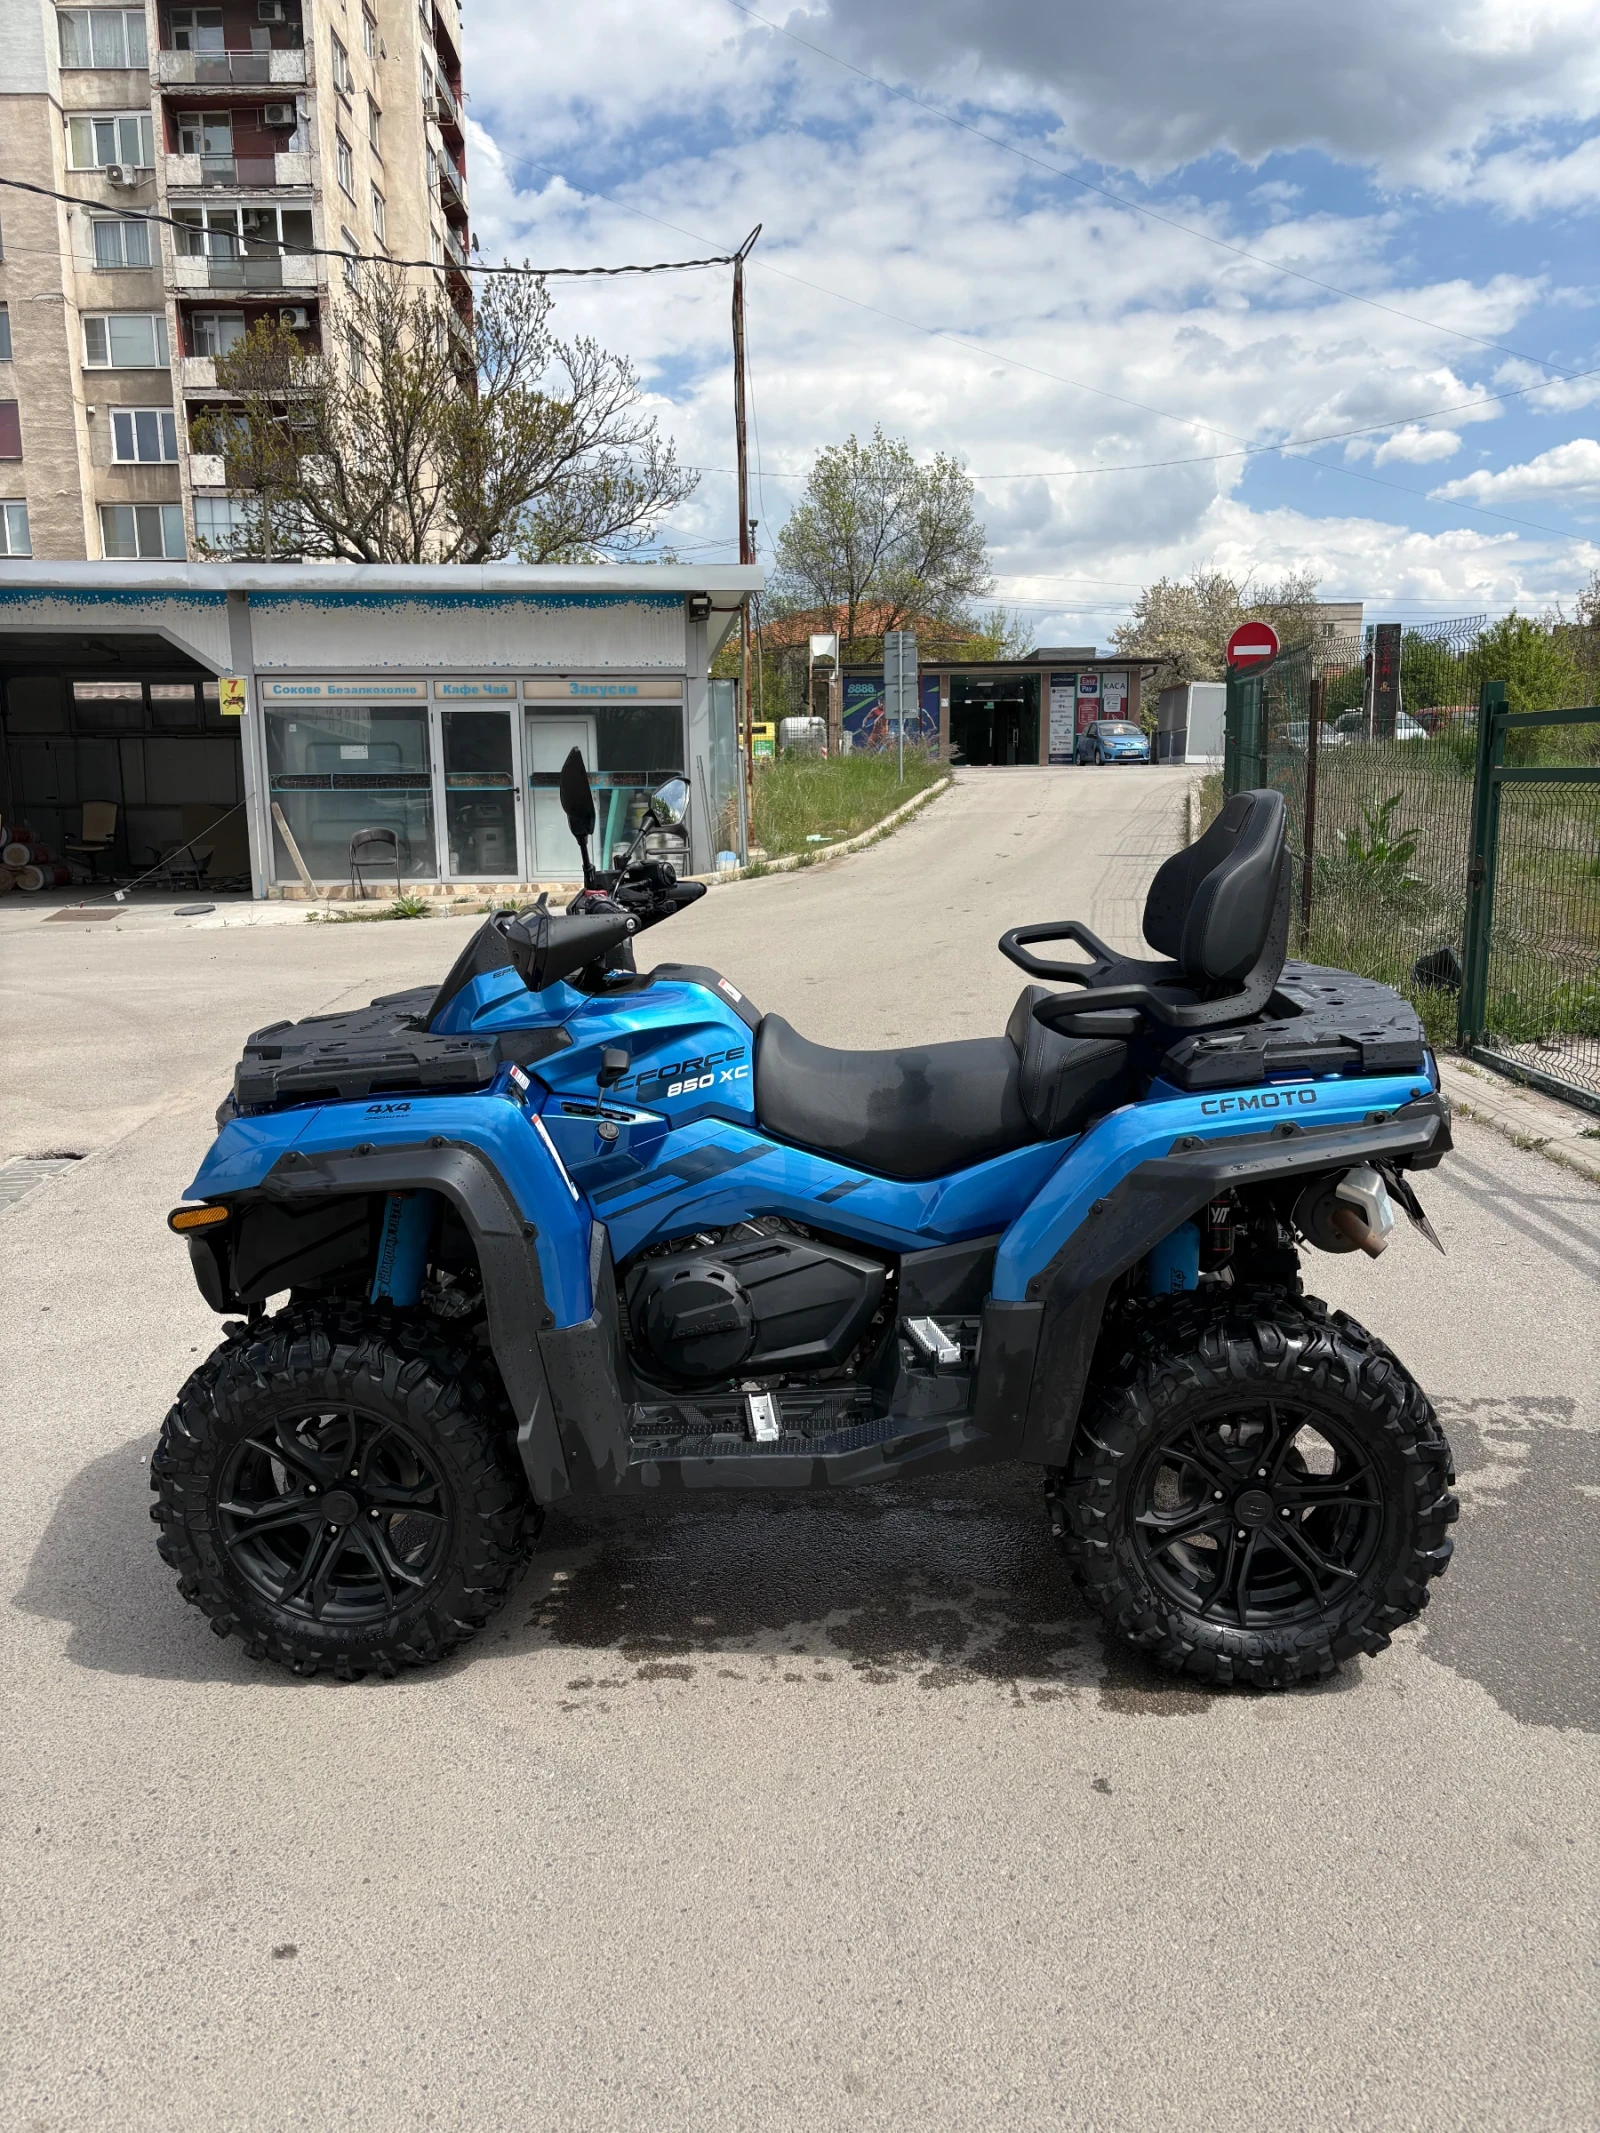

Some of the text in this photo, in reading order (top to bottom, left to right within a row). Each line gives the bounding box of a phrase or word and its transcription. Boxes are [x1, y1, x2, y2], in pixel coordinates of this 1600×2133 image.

[227, 680, 238, 693] 7
[1082, 677, 1096, 685] Easy
[1103, 682, 1126, 690] КАСА
[272, 684, 321, 695] Сокове
[443, 684, 509, 696] Кафе Чай
[569, 682, 638, 697] Закуски
[1081, 685, 1093, 693] Pay
[613, 1046, 745, 1092] CFORCE
[667, 1065, 749, 1097] 850 XC
[1200, 1089, 1317, 1116] CFMOTO
